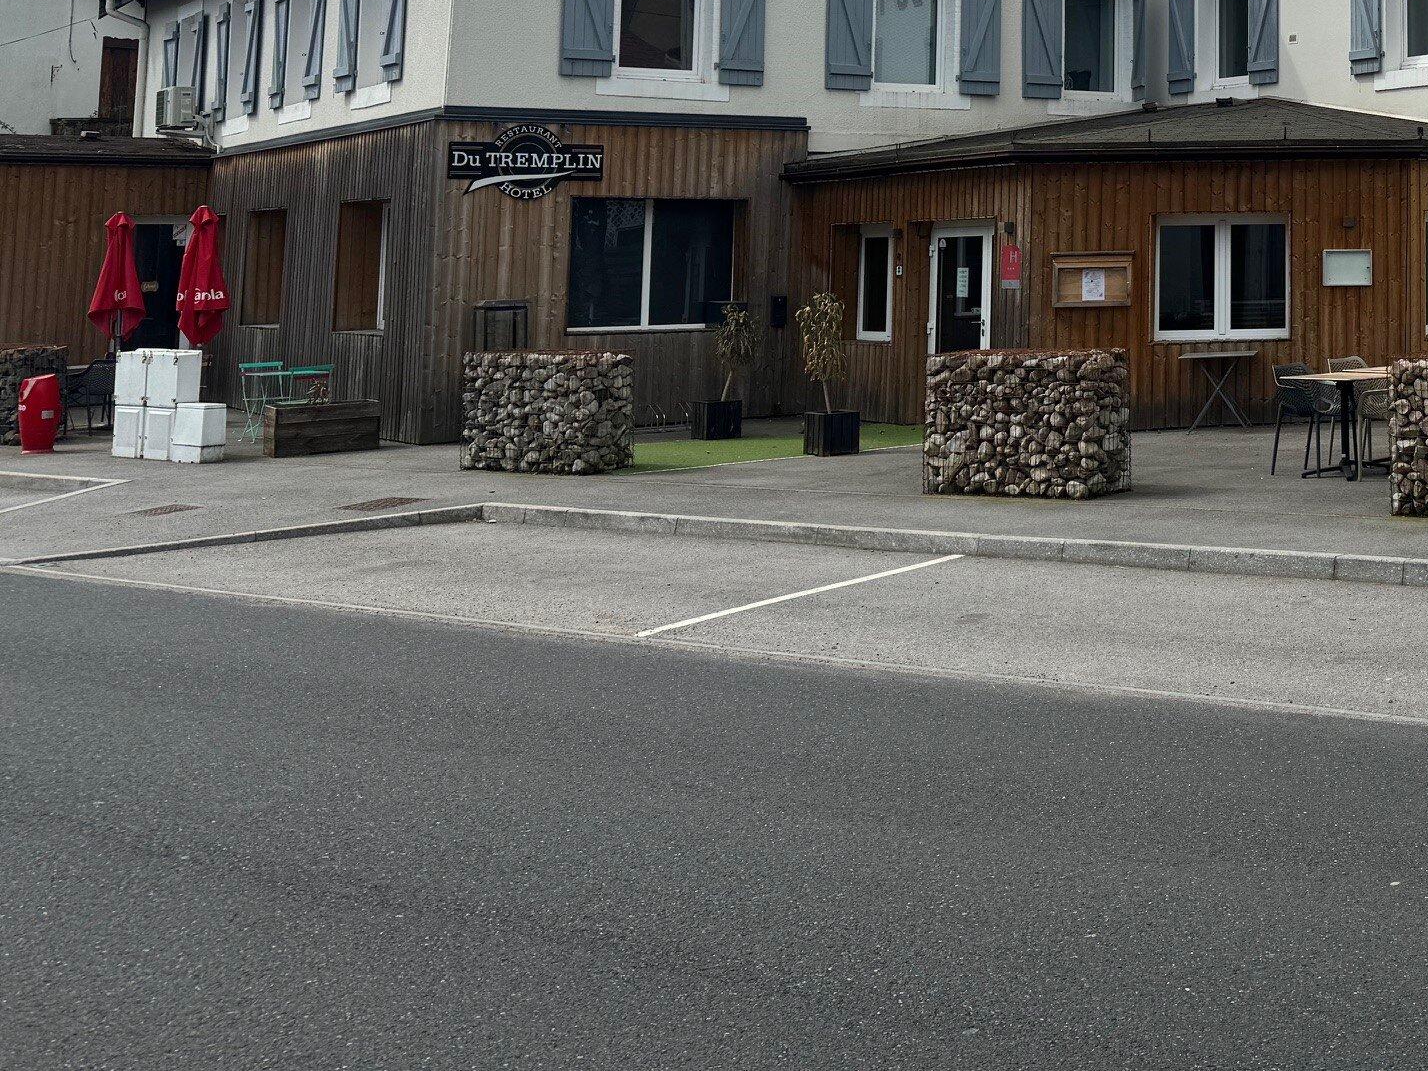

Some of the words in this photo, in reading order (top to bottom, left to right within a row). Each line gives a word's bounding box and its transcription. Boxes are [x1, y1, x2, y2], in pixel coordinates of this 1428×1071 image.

[494, 125, 562, 149] RESTAURANT
[452, 151, 482, 167] Du
[486, 152, 603, 169] TREMPLIN
[500, 182, 552, 200] HOTEL
